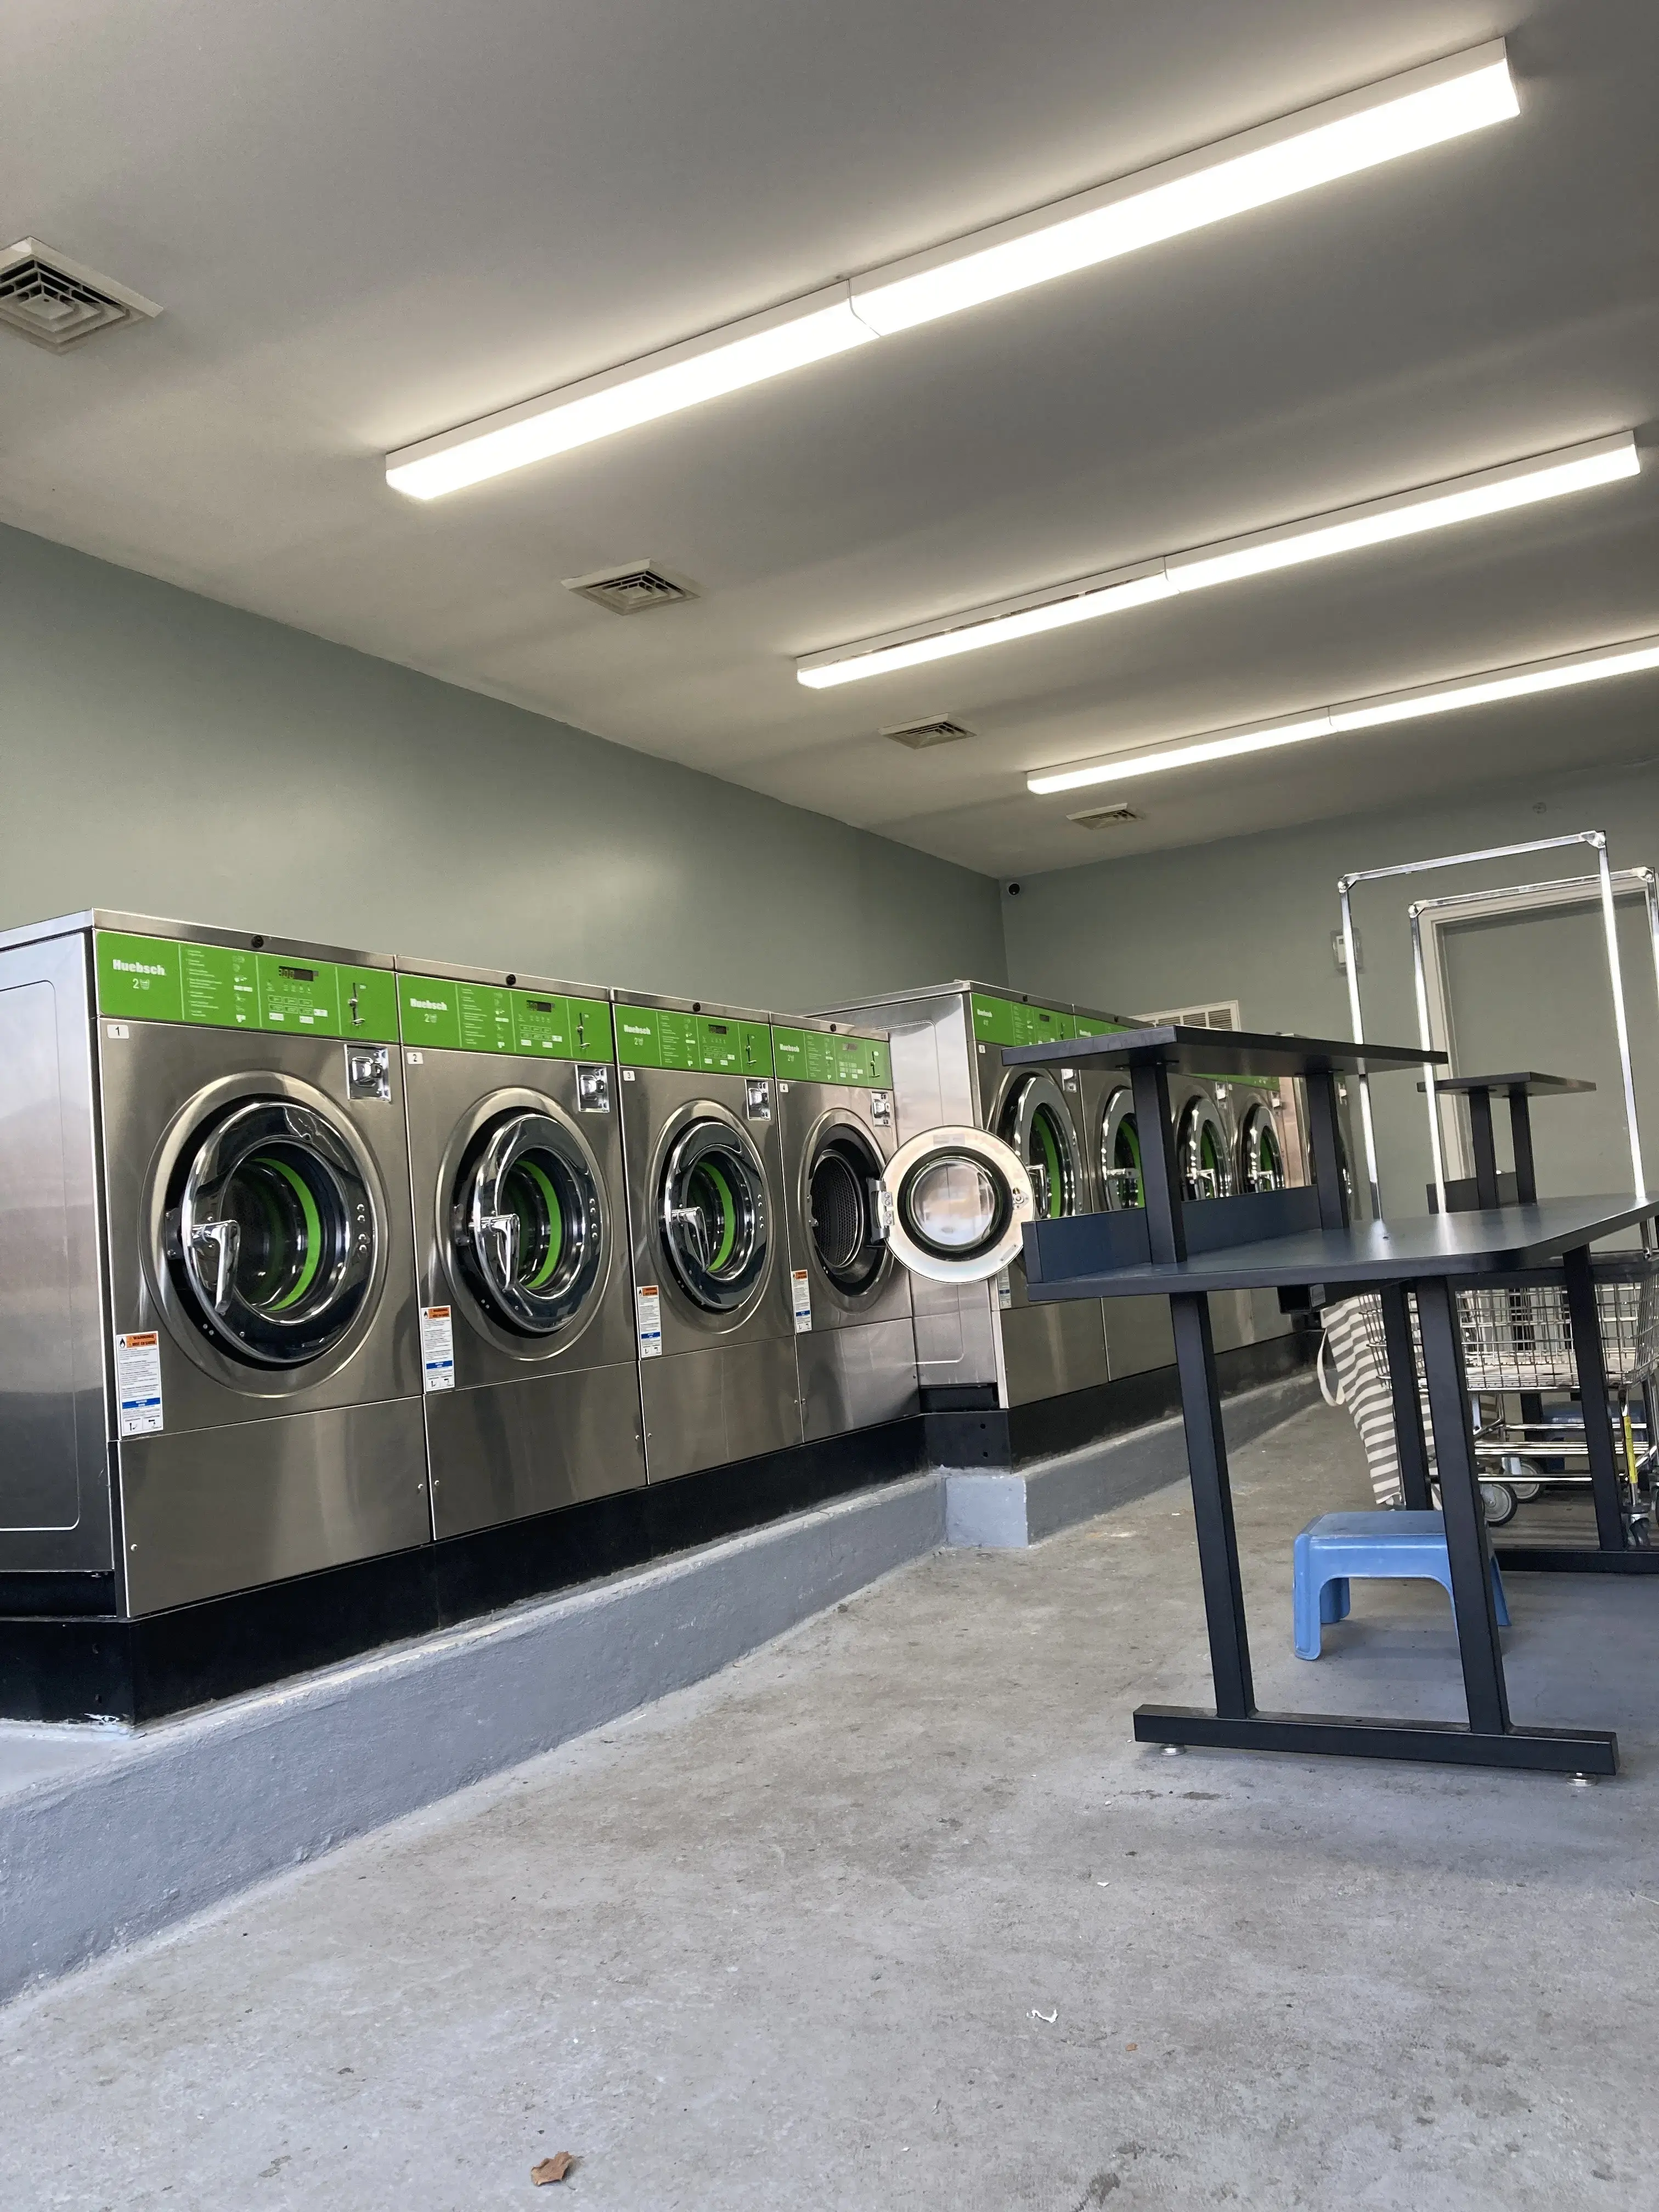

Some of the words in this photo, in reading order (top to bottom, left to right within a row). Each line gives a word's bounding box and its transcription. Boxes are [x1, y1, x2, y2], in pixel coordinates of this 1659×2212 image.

[112, 959, 165, 976] Huebsch
[132, 978, 139, 989] 2
[424, 1013, 430, 1023] 2
[115, 1026, 120, 1036] 1
[413, 1053, 417, 1062] 2
